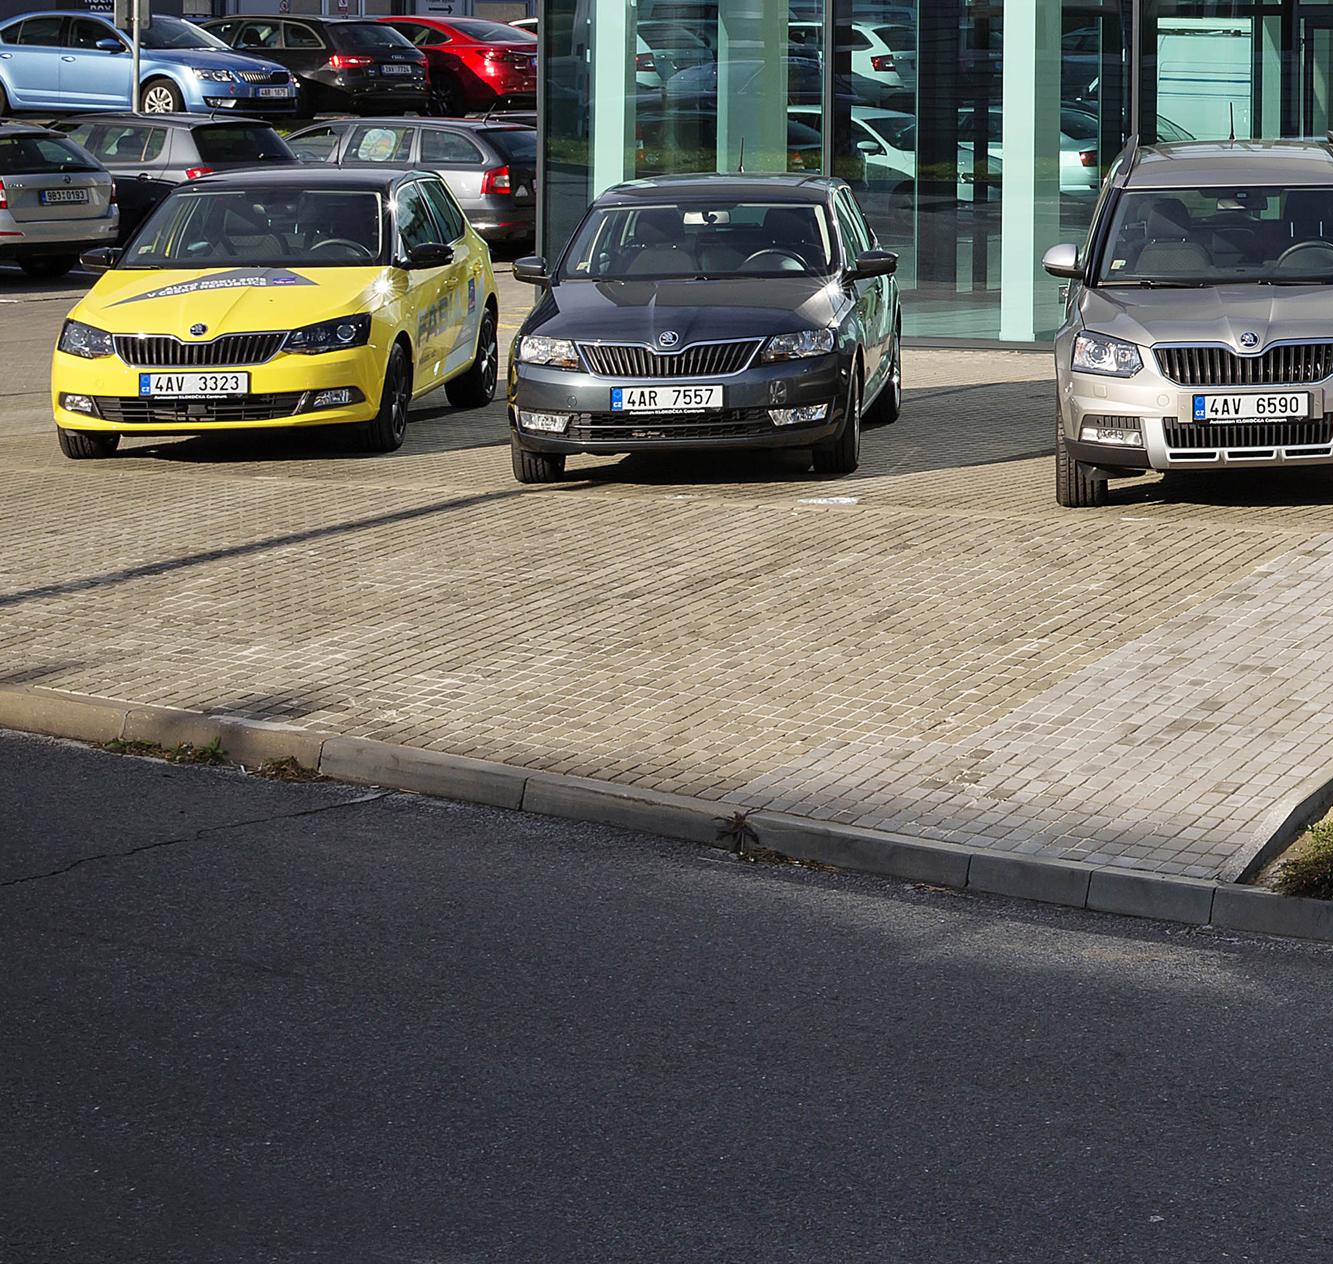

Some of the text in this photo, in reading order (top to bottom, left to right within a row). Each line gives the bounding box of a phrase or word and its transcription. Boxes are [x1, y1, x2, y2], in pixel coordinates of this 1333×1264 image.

[66, 190, 85, 200] 0193
[155, 376, 185, 392] 4AV
[198, 375, 240, 391] 3323
[627, 390, 658, 407] 4AR
[672, 388, 714, 406] 7557
[1209, 398, 1241, 416] 4AV
[1256, 396, 1299, 414] 6590
